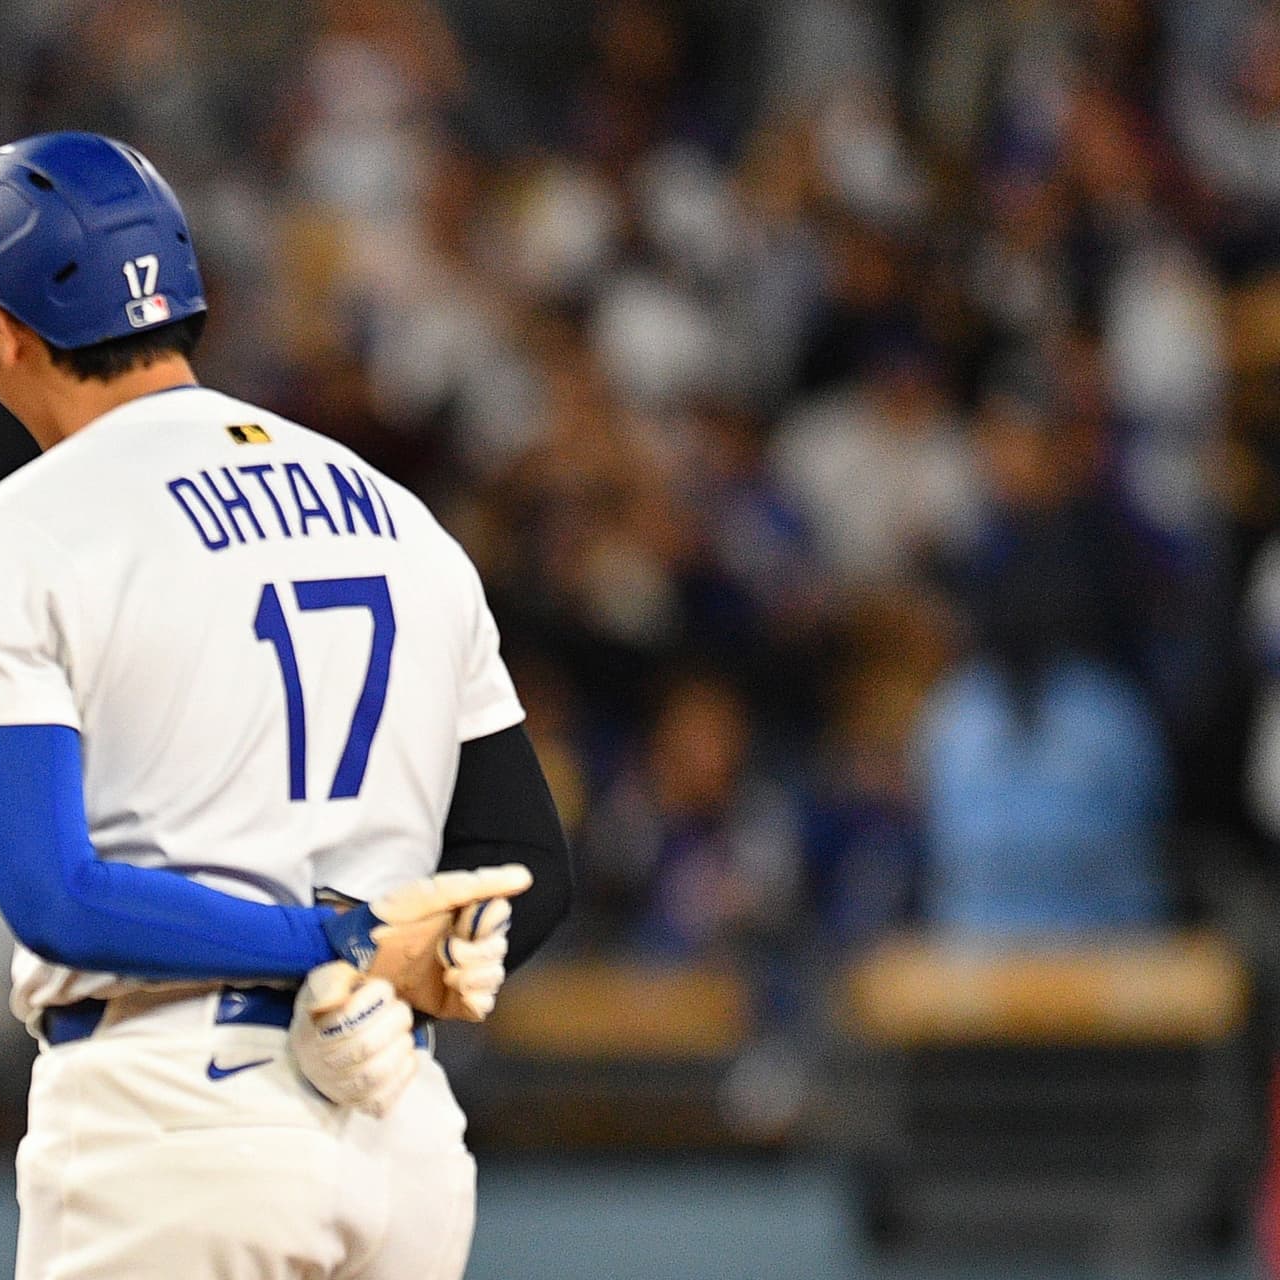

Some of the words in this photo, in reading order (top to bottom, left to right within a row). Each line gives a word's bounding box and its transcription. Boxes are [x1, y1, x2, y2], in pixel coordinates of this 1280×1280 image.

[122, 253, 160, 300] 17
[167, 462, 397, 552] OHTANI
[254, 575, 396, 801] 17
